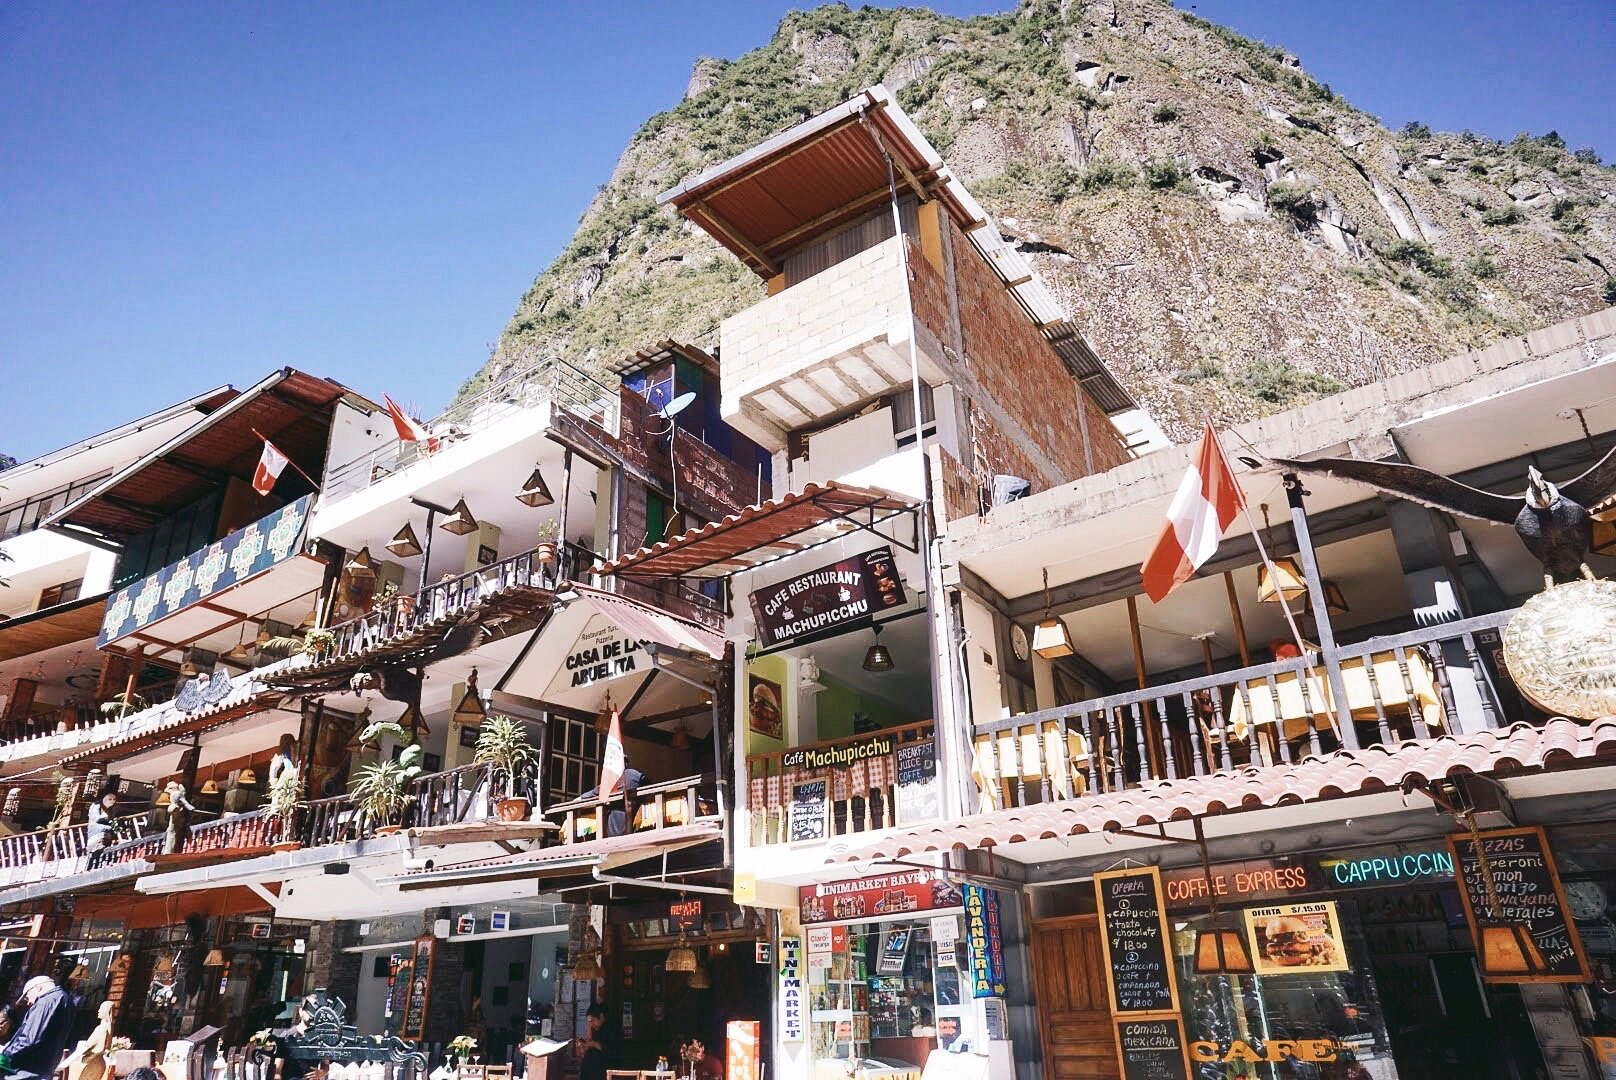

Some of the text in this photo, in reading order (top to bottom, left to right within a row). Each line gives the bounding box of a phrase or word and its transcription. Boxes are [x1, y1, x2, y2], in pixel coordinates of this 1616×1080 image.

[764, 571, 862, 616] CAFE RESTAURANT
[774, 599, 868, 640] MACHUPICCHU
[565, 638, 642, 670] CASA DE LA
[571, 655, 636, 687] ABUELITA
[784, 737, 890, 768] Café Machupicchu
[898, 743, 934, 760] BREAKFAST
[898, 757, 921, 770] JUICE
[898, 768, 922, 782] COFFE
[1467, 838, 1525, 853] PZZAS
[816, 879, 888, 897] INIMARKET
[1235, 866, 1306, 893] EXPRESS
[1252, 904, 1327, 917] OFERTA S/.15.00
[968, 886, 990, 990] LAVANDERIA
[783, 940, 801, 1038] MINIMARKET
[1189, 1039, 1337, 1062] CAFE
